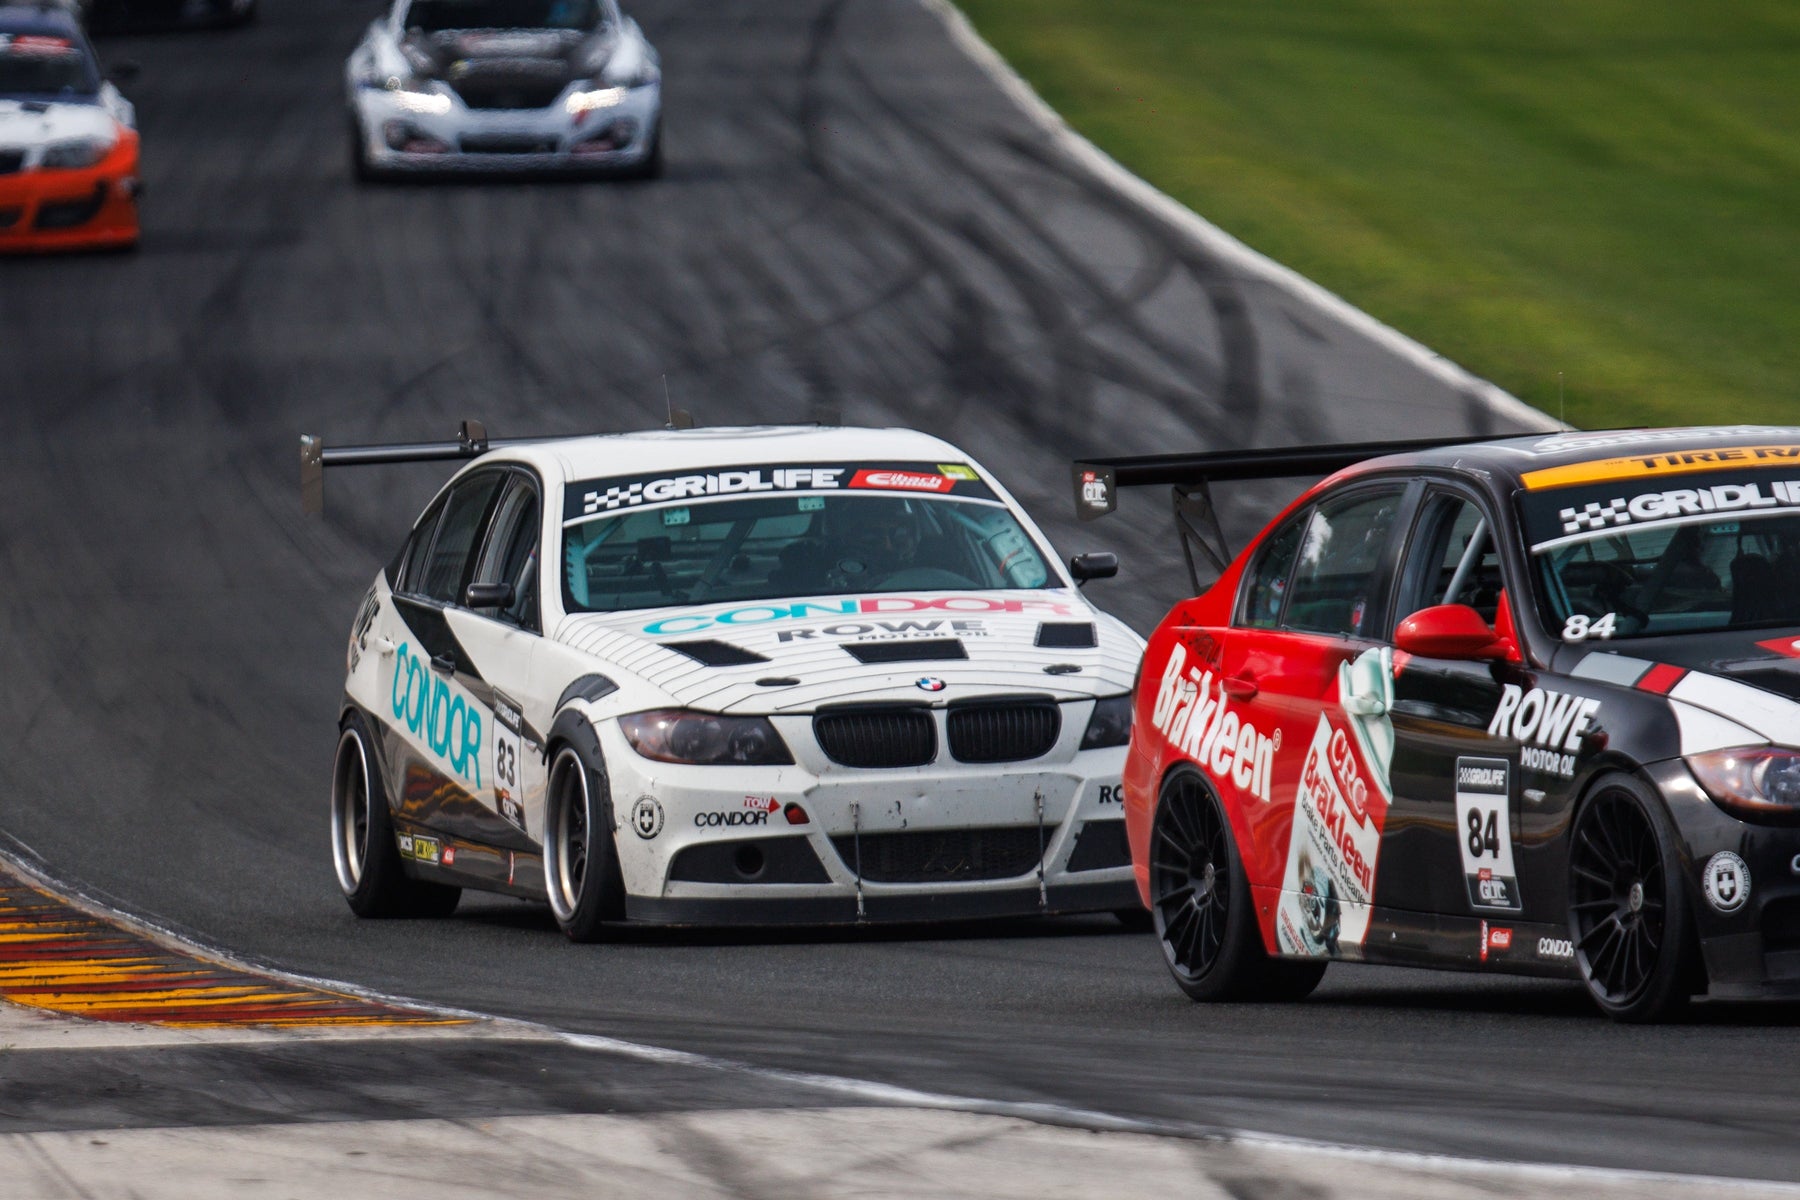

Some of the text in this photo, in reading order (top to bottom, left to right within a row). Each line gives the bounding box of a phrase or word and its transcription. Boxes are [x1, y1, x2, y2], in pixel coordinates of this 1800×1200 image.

[1631, 450, 1749, 468] TIRE
[643, 468, 845, 500] GRIDLIFE
[642, 597, 1072, 635] CONDOR
[1562, 612, 1617, 642] 84
[777, 620, 986, 643] ROWE
[858, 631, 946, 641] MOTOR
[392, 641, 482, 790] CONDOR
[1488, 683, 1601, 750] ROWE
[497, 737, 515, 787] 83
[1331, 728, 1368, 815] CRC
[1521, 746, 1576, 776] MOTOR OIL
[1470, 768, 1506, 786] GRIDLIFE
[745, 798, 771, 809] TOW
[694, 811, 769, 827] CONDOR
[1467, 807, 1500, 859] 84
